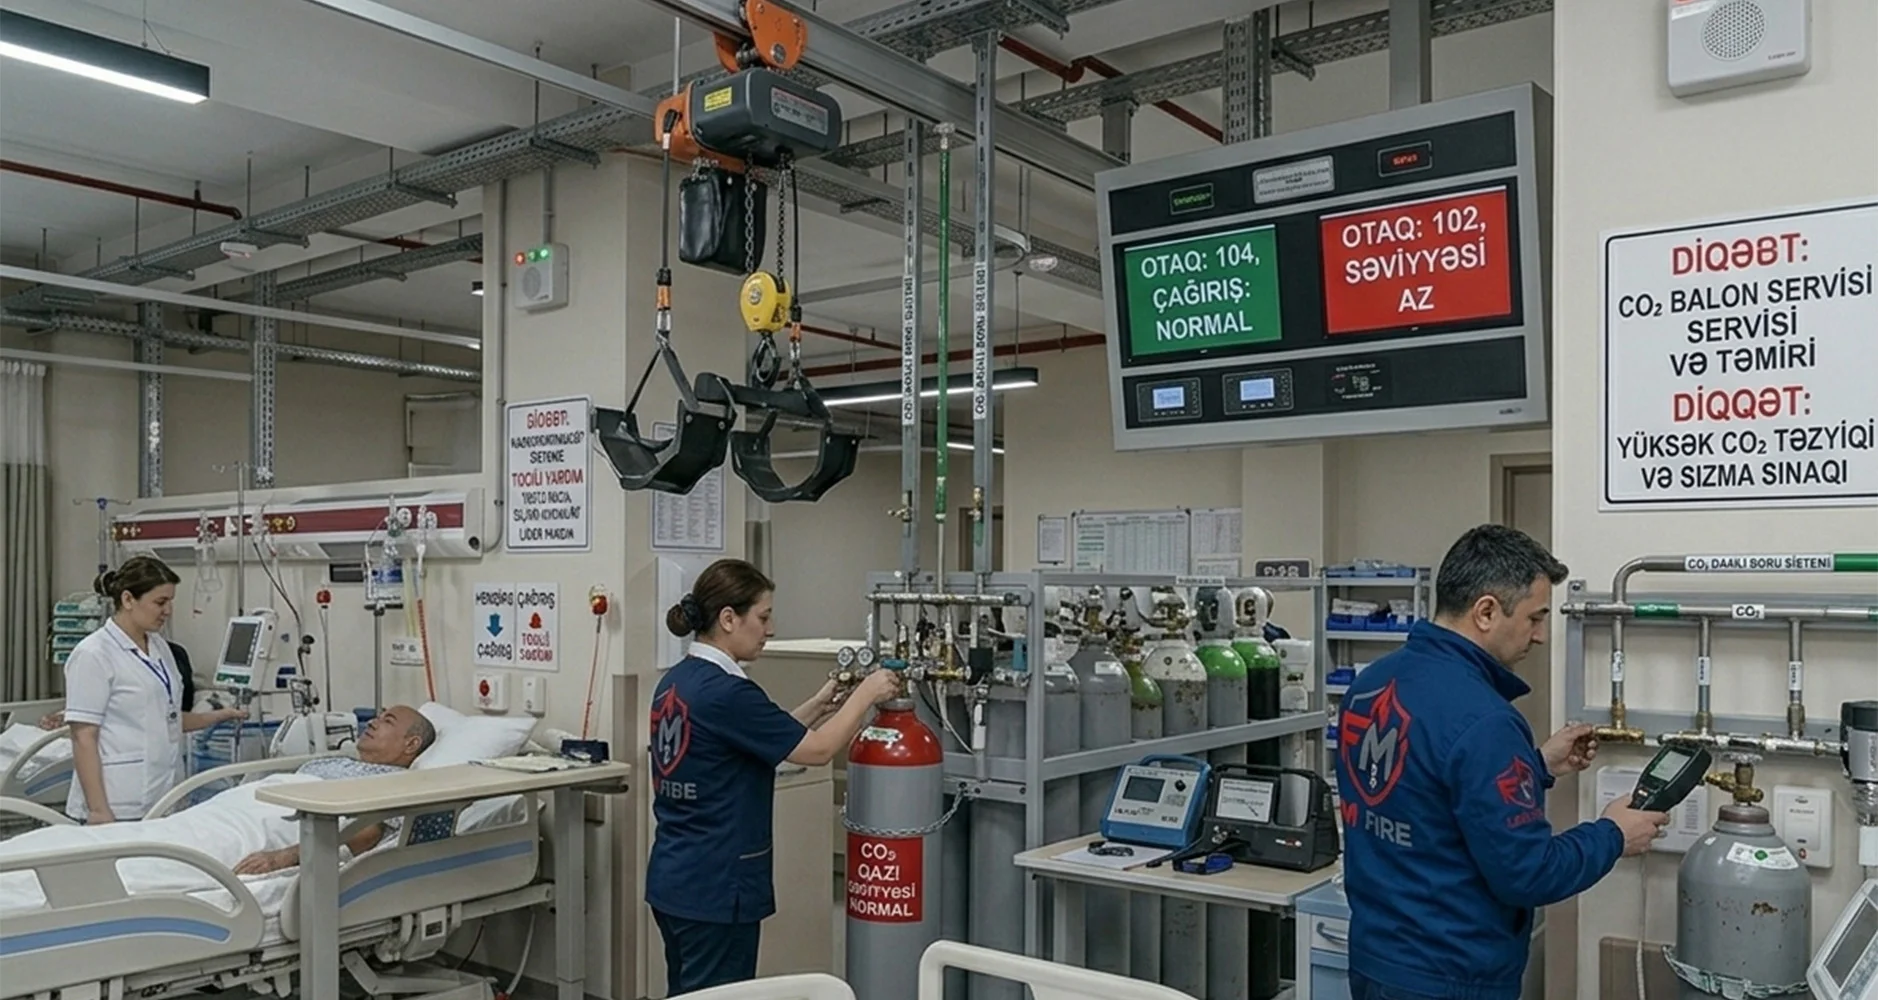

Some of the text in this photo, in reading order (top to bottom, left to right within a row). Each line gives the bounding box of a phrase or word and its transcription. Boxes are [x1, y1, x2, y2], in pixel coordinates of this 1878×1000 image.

[1342, 206, 1486, 248] OTAQ: 102,
[1141, 242, 1260, 279] OTAQ: 104,
[1345, 236, 1486, 284] SƏVİYYƏSİ
[1672, 233, 1808, 276] DİQƏBT:
[1153, 277, 1251, 314] ÇAĞIRIŞ:
[1398, 285, 1435, 313] AZ
[1671, 281, 1758, 313] BALON
[1767, 264, 1873, 304] SERVİSİ
[1156, 310, 1253, 341] NORMAL
[1687, 305, 1797, 344] SERVİSİ
[1670, 337, 1816, 377] VƏ TƏMİRİ
[1673, 386, 1811, 423] DİQQƏT:
[1617, 431, 1714, 459] YÜKSƏK
[1774, 418, 1875, 452] TƏZYİQİ
[1641, 460, 1847, 490] VƏ SIZMA SINAQI
[1364, 809, 1413, 848] FIRE
[849, 897, 914, 917] NORMAL
